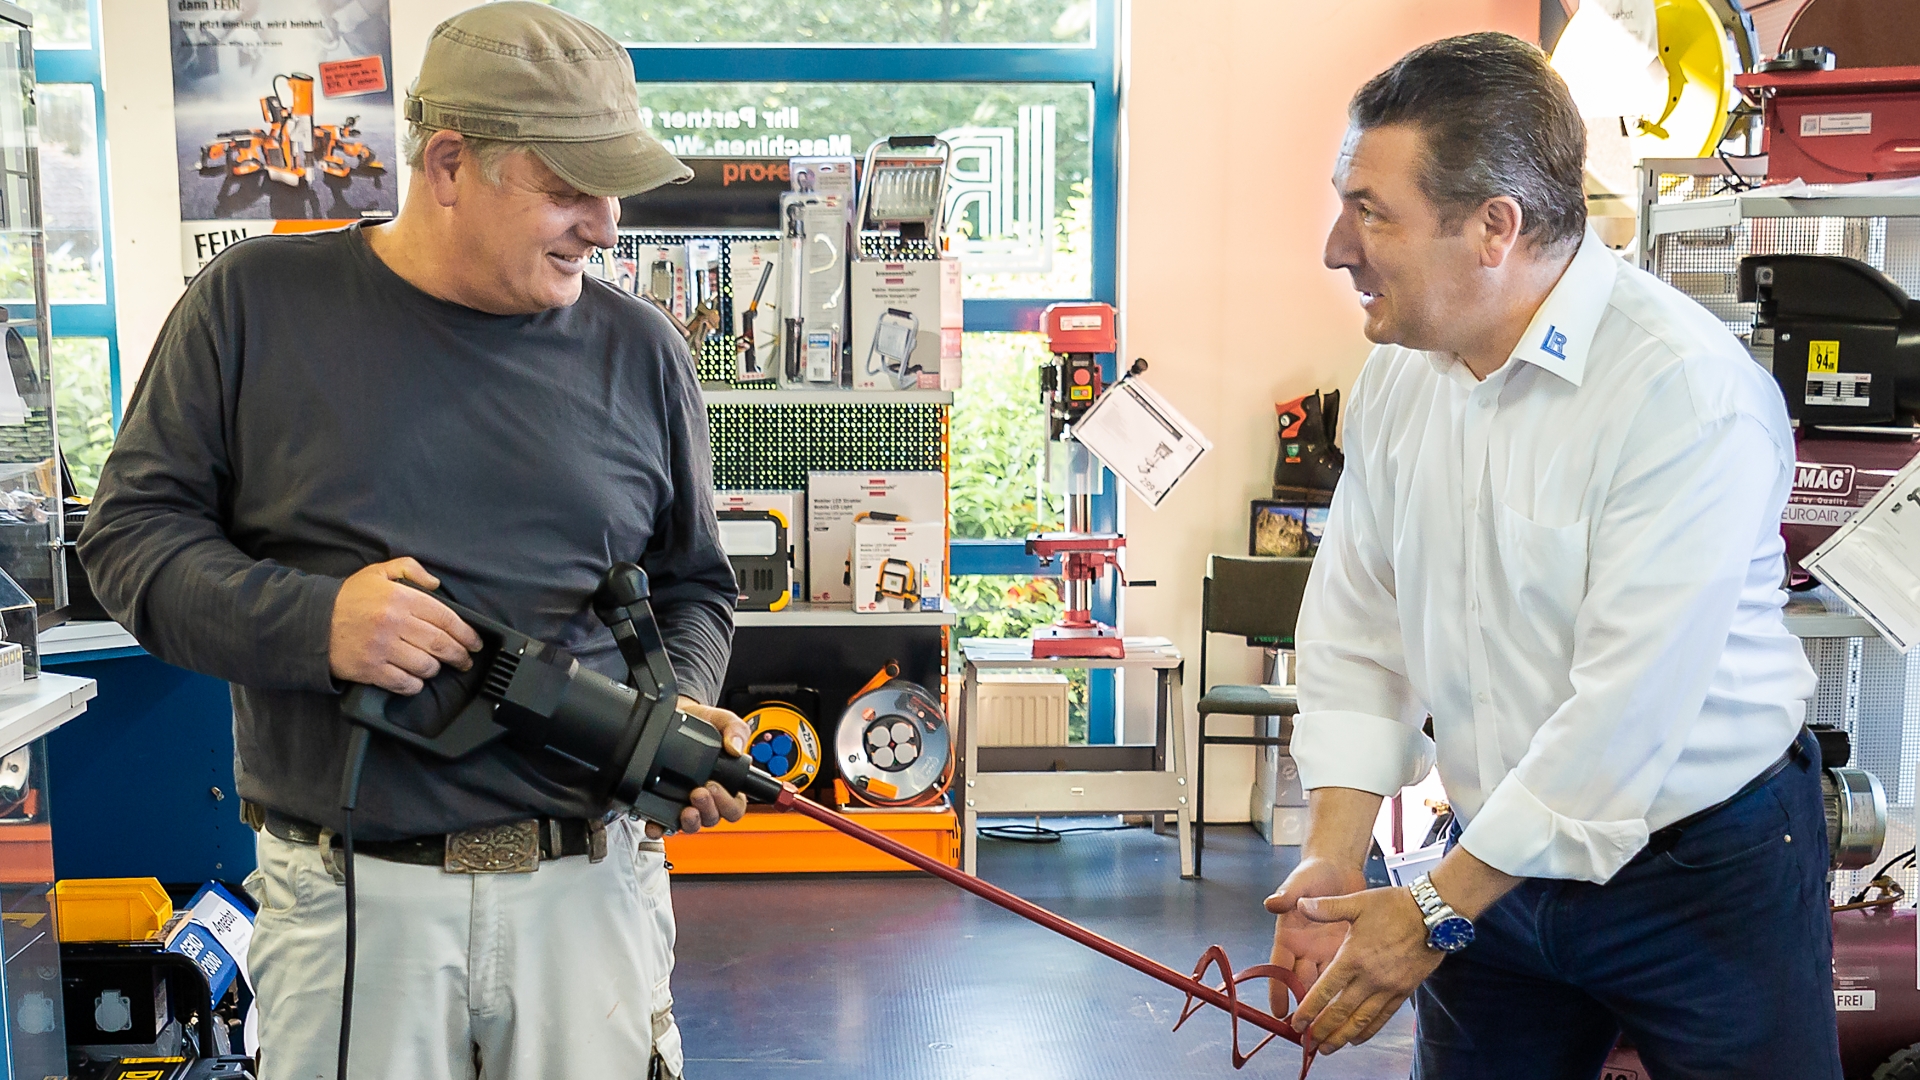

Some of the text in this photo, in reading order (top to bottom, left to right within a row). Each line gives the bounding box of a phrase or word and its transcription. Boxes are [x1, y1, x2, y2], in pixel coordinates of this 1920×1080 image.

[1816, 353, 1829, 370] 94
[1794, 468, 1845, 490] MAG
[1817, 497, 1849, 507] Quality
[211, 908, 238, 935] Angebot
[180, 932, 205, 961] GEKO
[1836, 995, 1863, 1007] FREI
